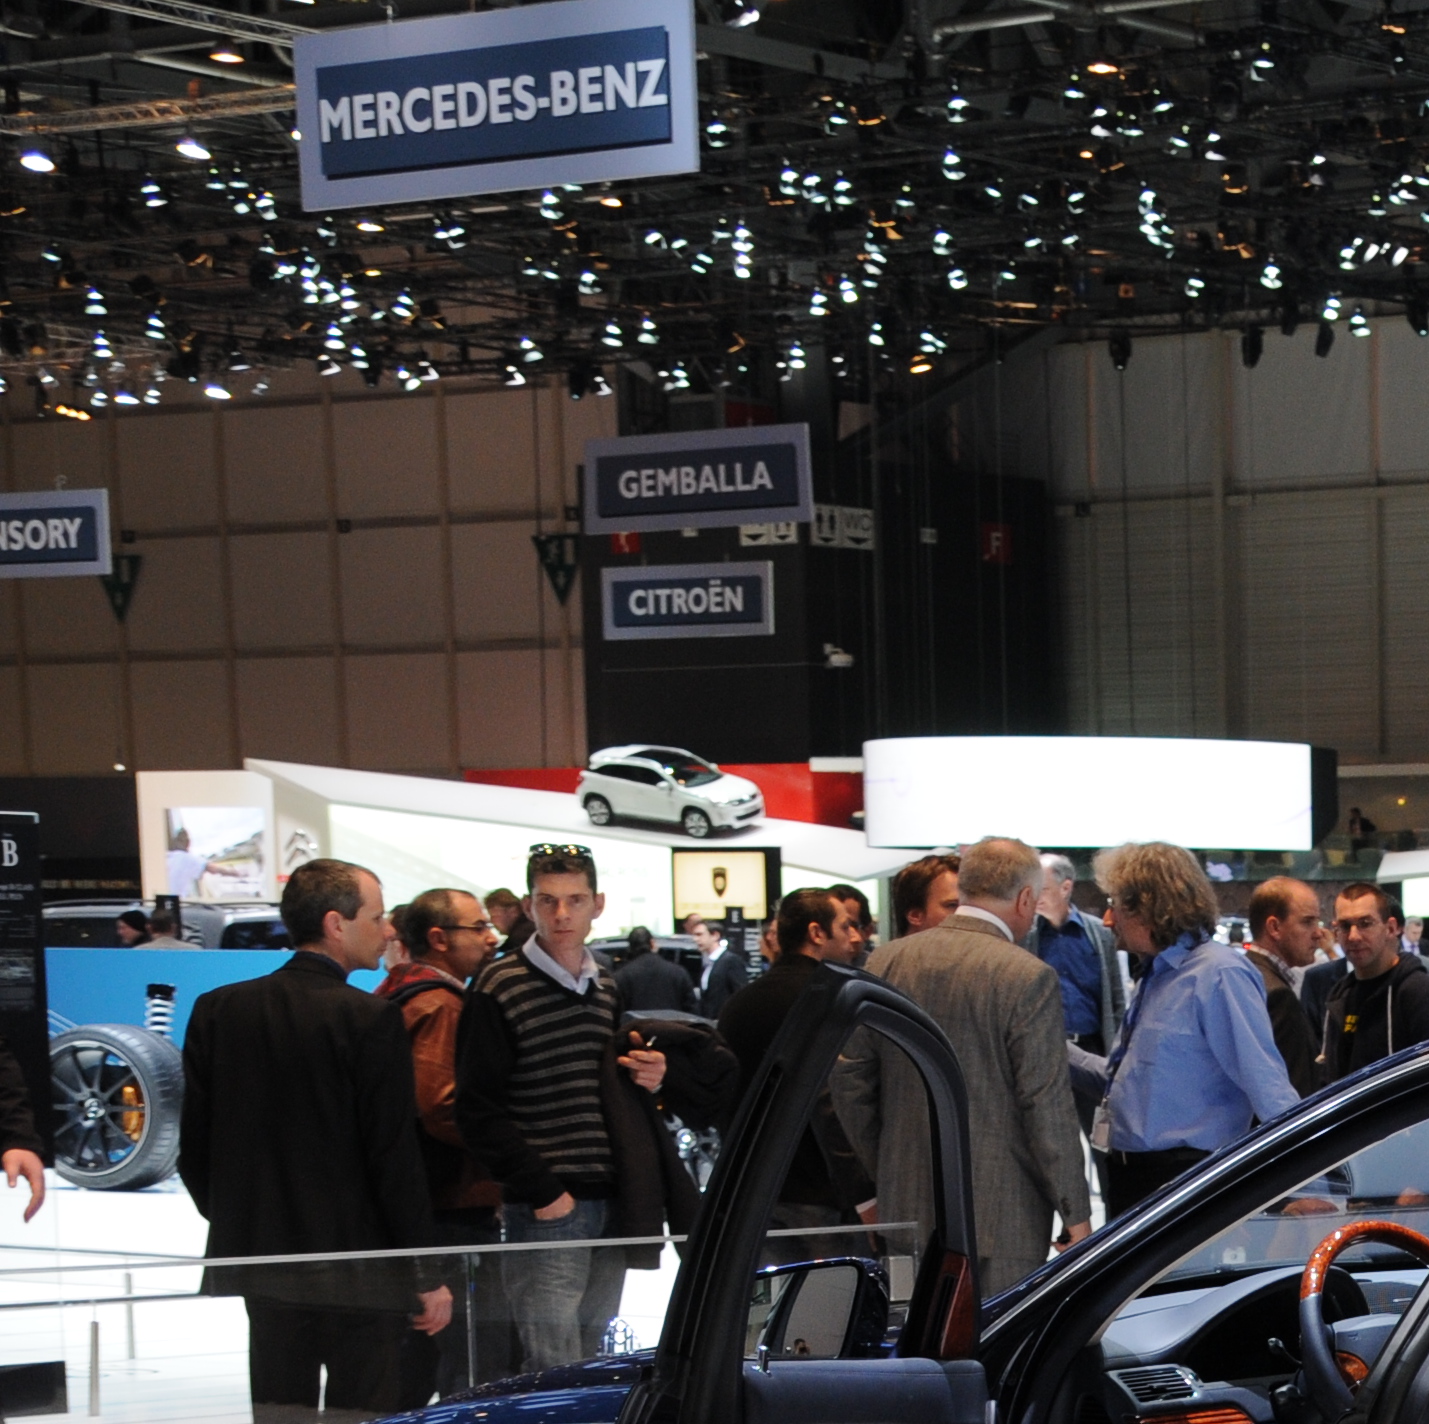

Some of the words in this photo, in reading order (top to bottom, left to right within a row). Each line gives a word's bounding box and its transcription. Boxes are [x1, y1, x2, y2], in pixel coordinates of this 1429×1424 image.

[320, 58, 668, 143] MERCEDES-BENZ
[618, 461, 774, 499] GEMBALLA
[628, 578, 744, 617] CITROËN
